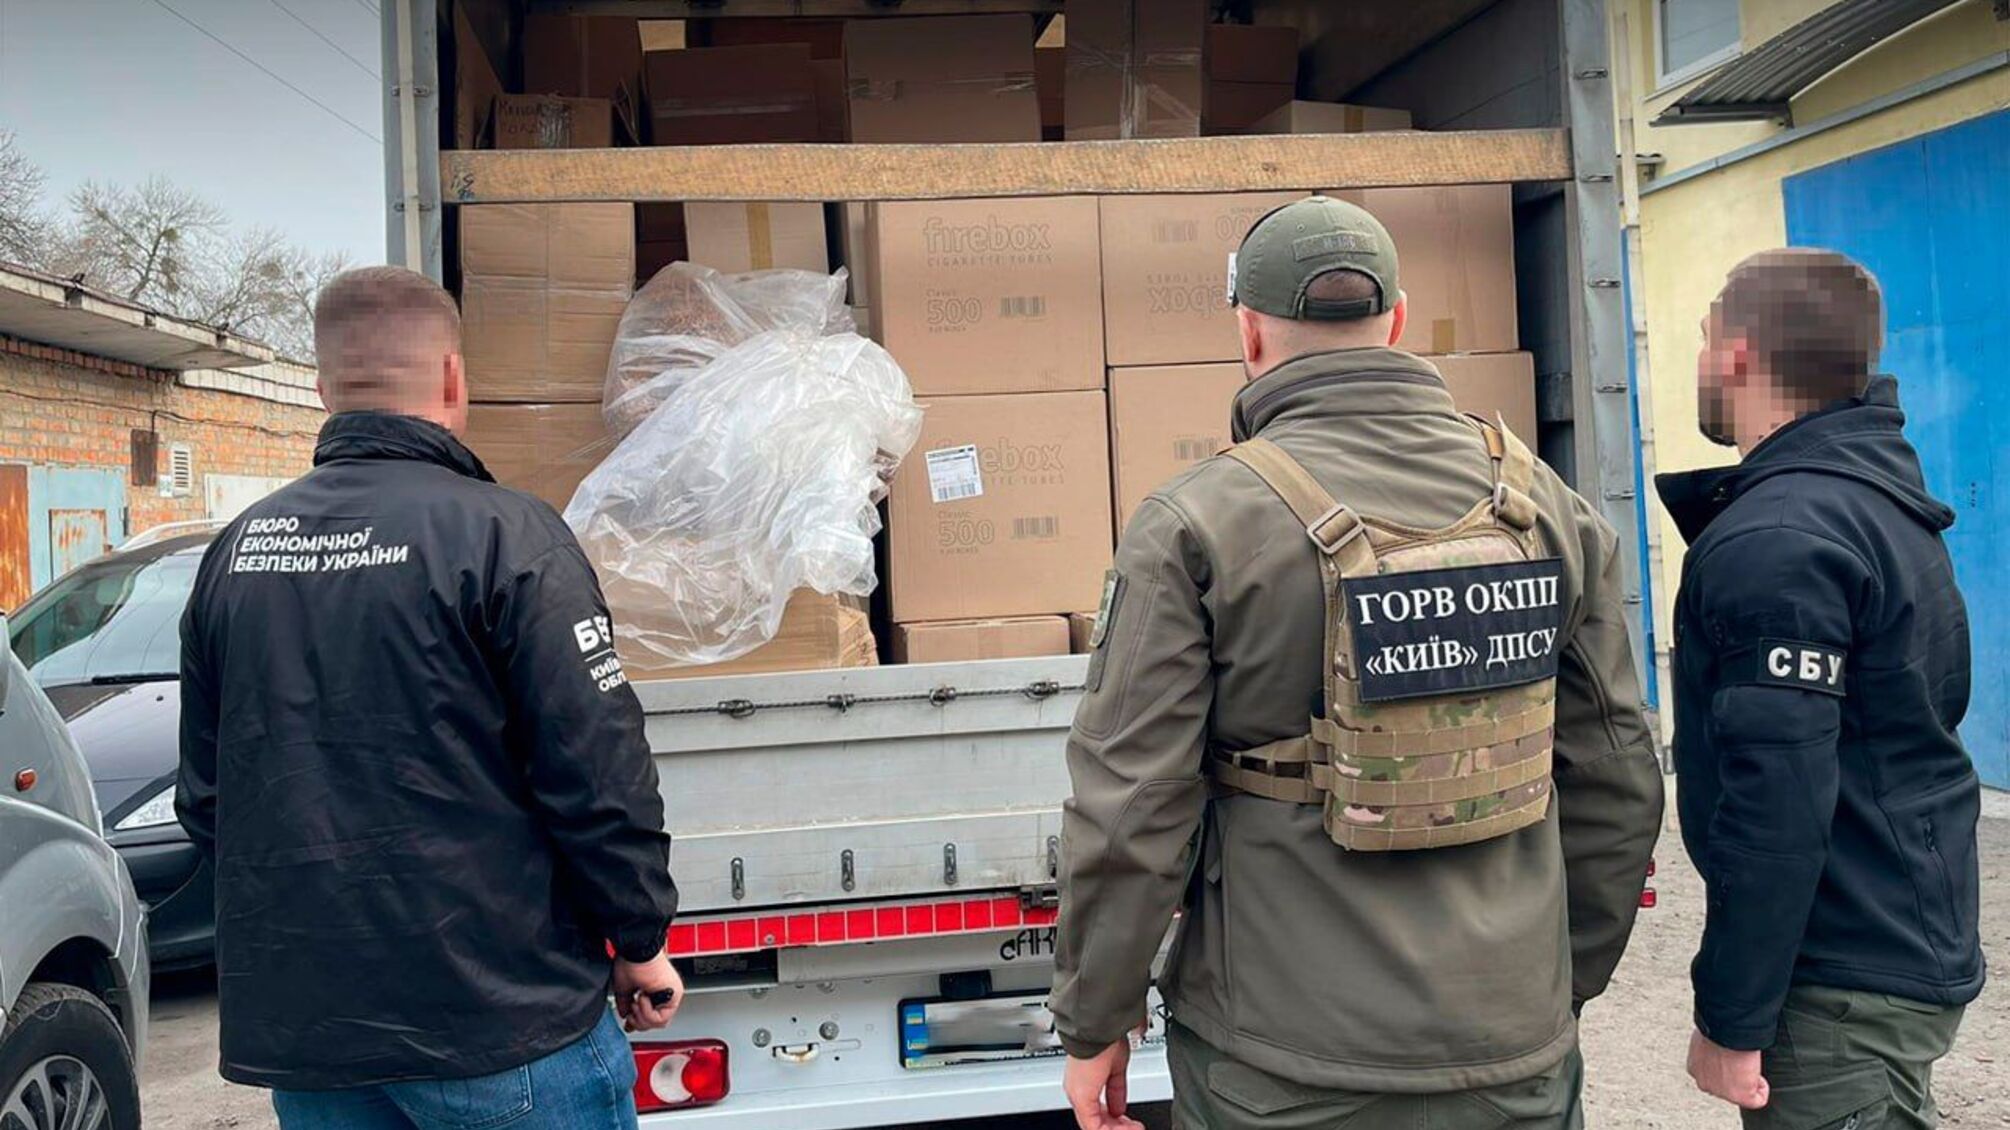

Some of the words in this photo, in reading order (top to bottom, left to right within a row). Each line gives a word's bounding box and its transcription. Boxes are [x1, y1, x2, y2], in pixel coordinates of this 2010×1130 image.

[923, 213, 1052, 254] firebox
[927, 297, 982, 324] 500
[239, 527, 373, 553] ЕКОНОМІЧНОЇ
[247, 517, 299, 534] БЮРО
[938, 519, 995, 547] 500
[233, 555, 318, 573] БЕЗПЕКИ
[321, 544, 409, 571] УКРАЇНИ
[1356, 586, 1456, 625] ГОРВ
[1464, 575, 1559, 614] ОКПП
[1366, 635, 1478, 675] «КИЇВ»
[1486, 627, 1558, 670] ДПСУ
[1767, 646, 1842, 685] СБУ
